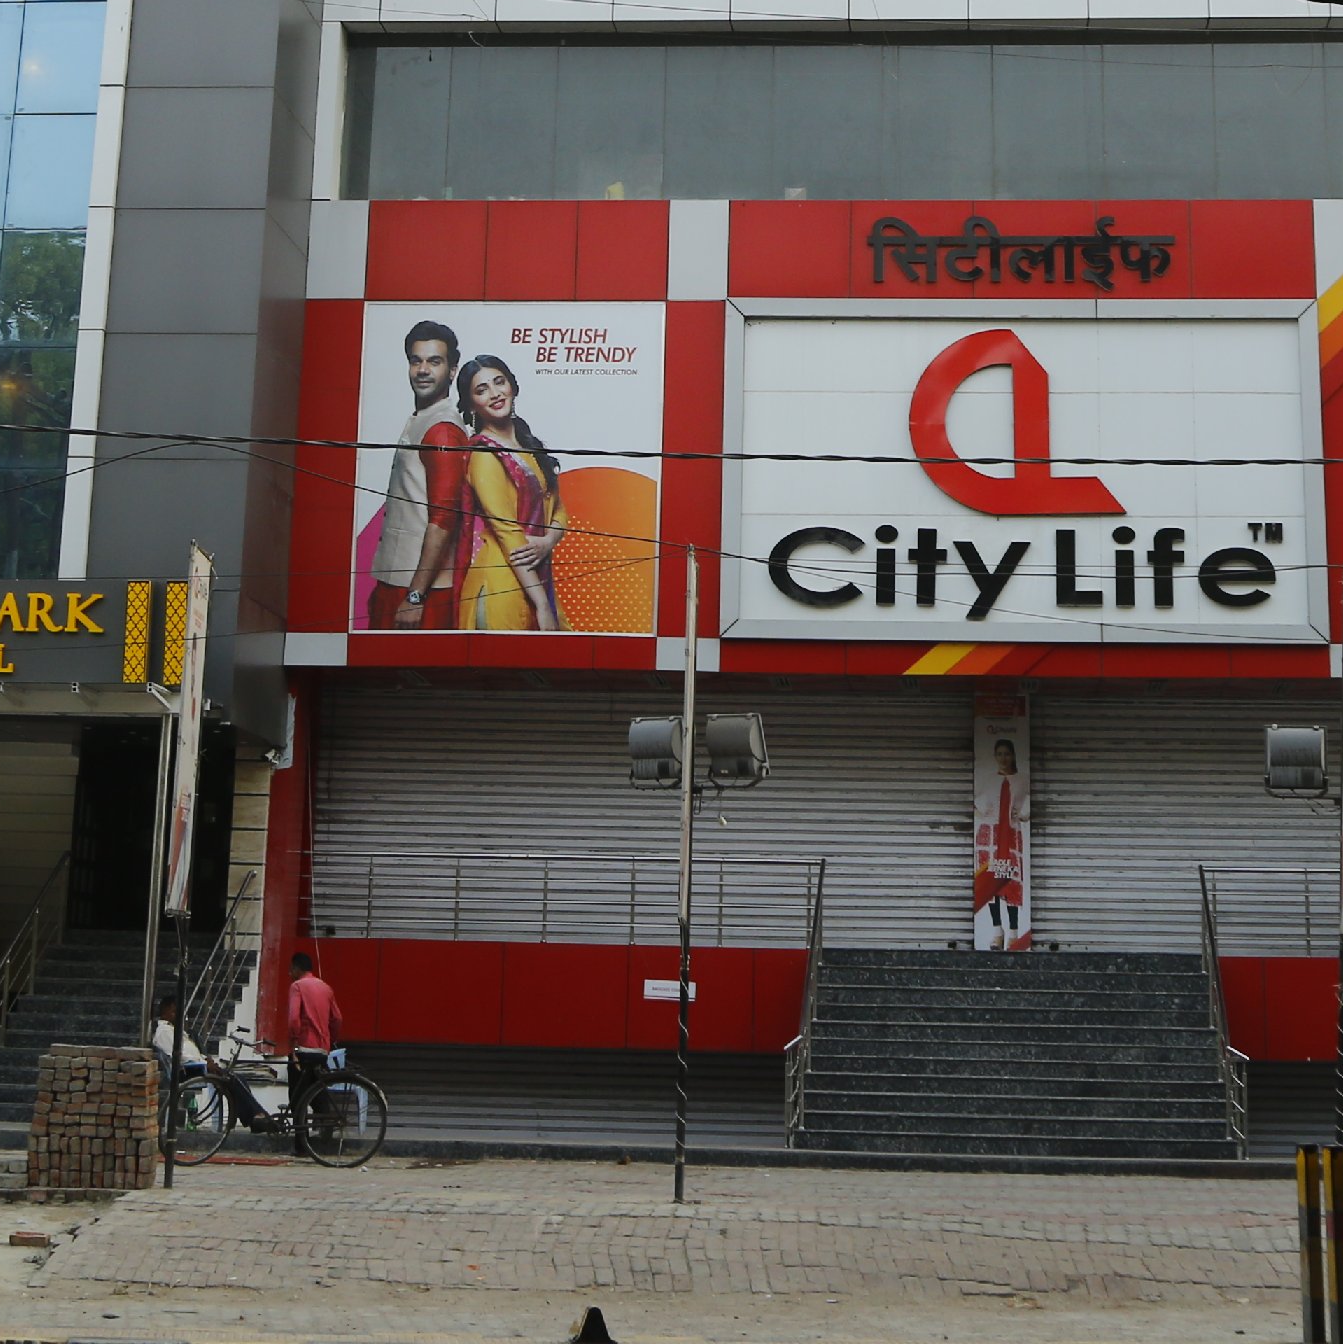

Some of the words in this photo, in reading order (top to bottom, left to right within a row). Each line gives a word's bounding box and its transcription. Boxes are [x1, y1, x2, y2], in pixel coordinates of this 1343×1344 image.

[866, 215, 1176, 292] सिटीलाईफ
[510, 328, 533, 344] BE
[537, 328, 608, 344] STYLISH
[535, 346, 558, 363] BE
[564, 346, 638, 363] TRENDY
[595, 368, 638, 376] COLLECTION
